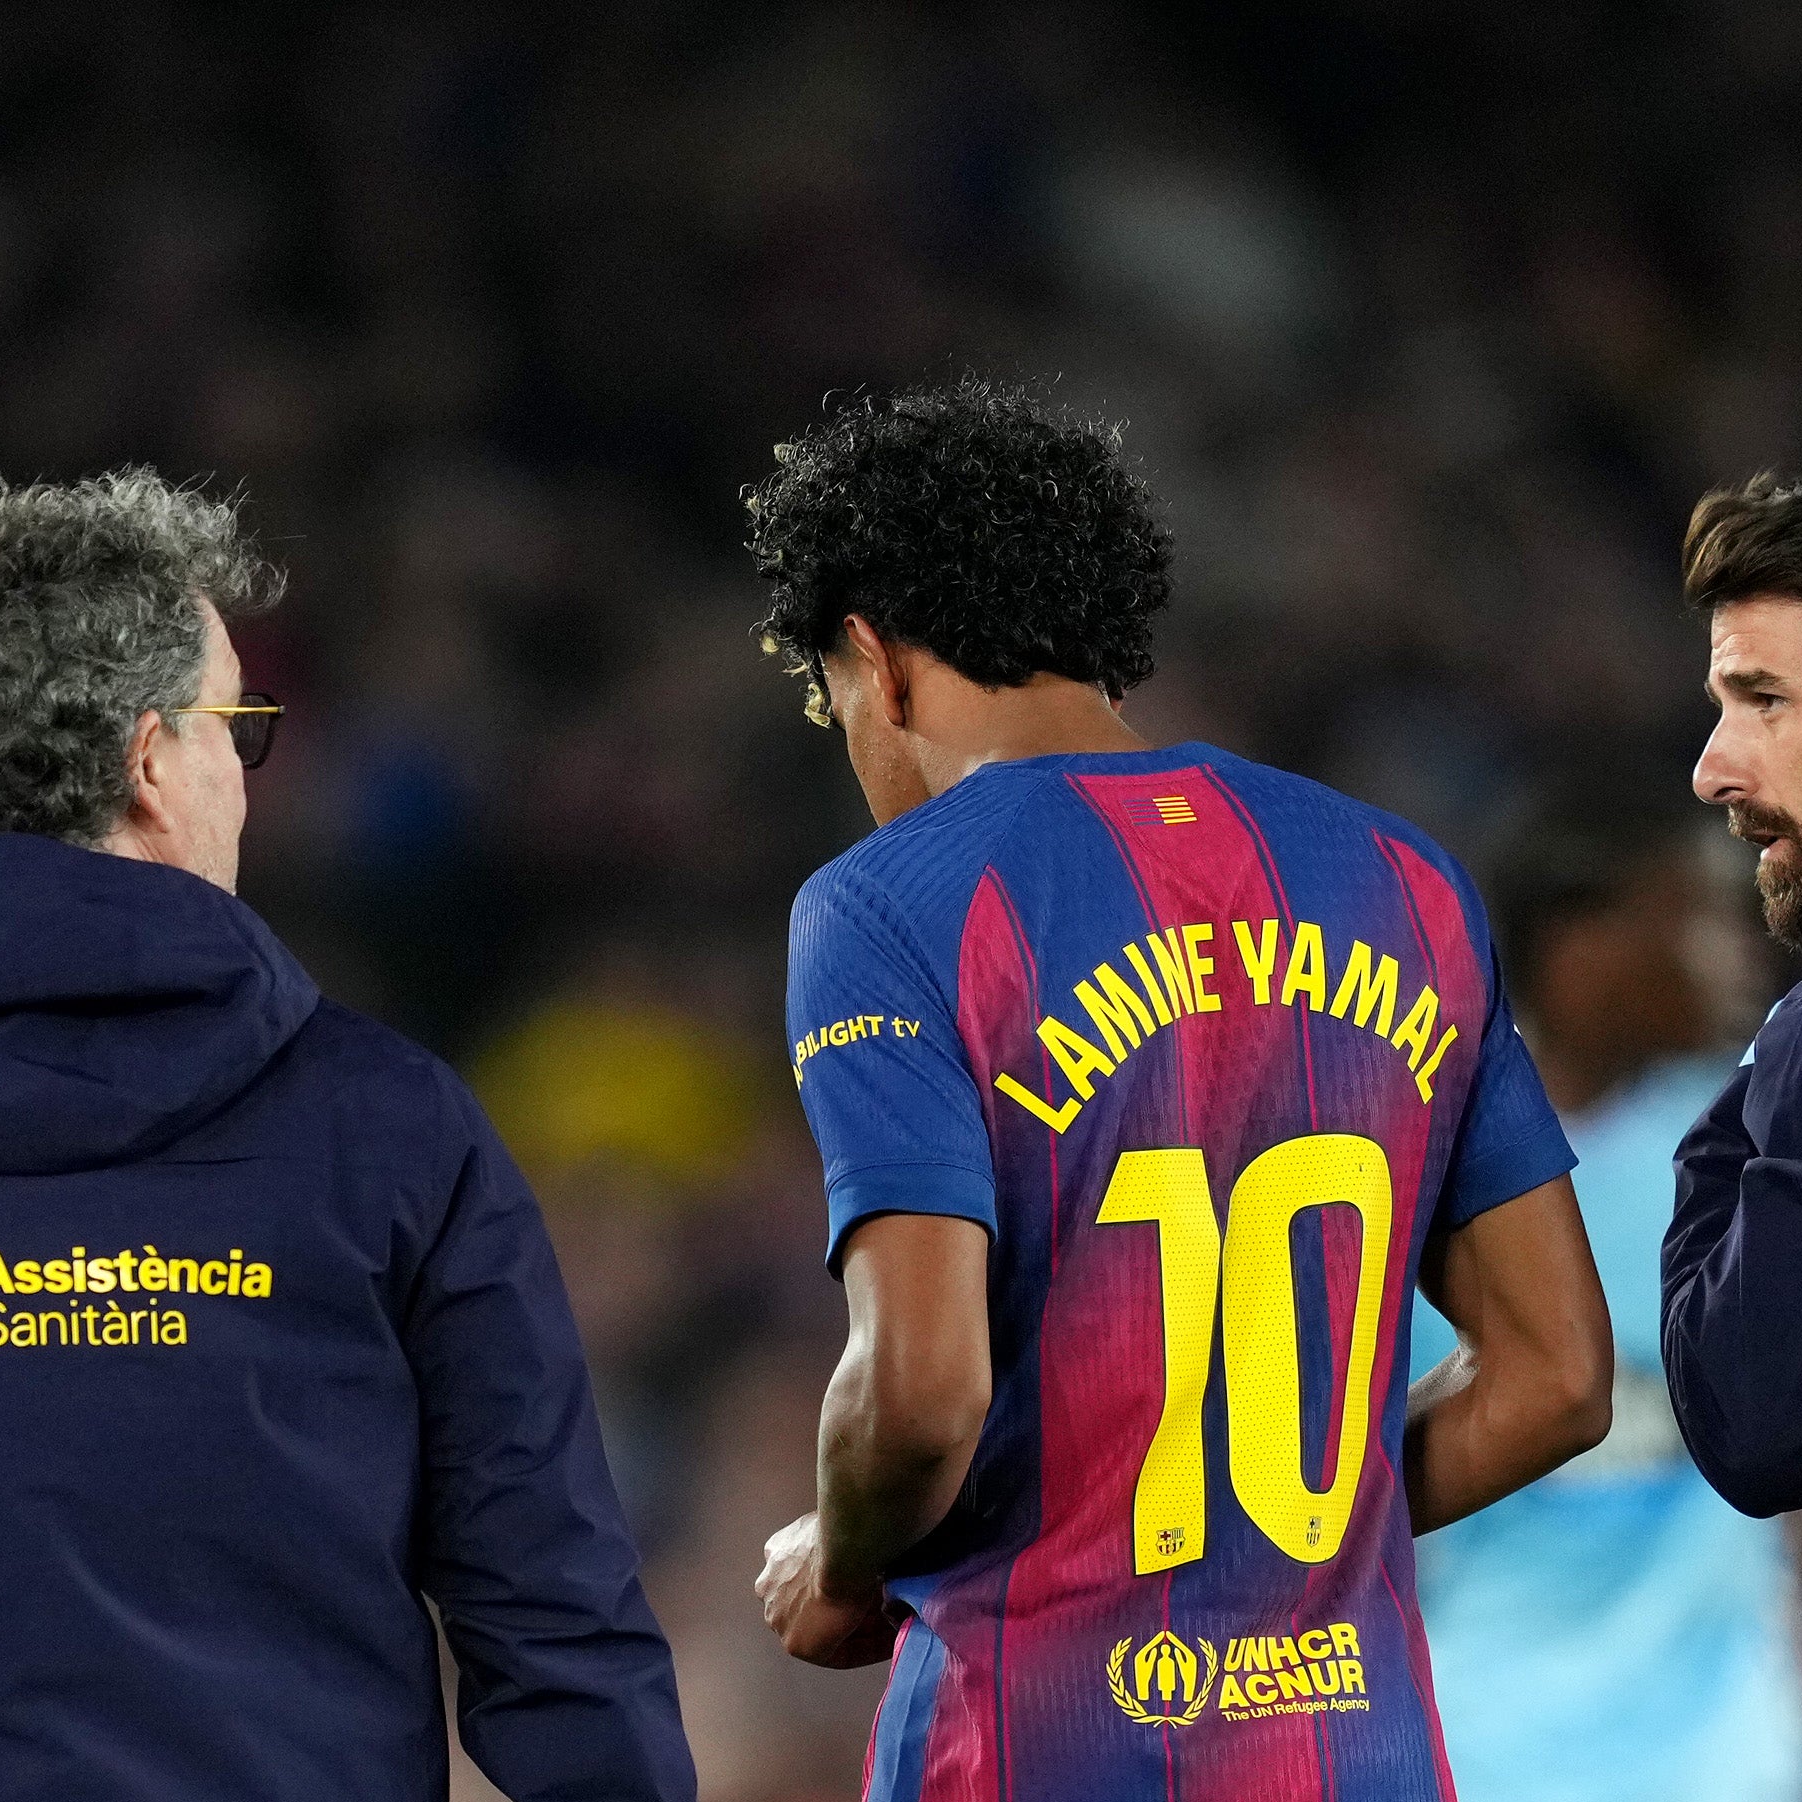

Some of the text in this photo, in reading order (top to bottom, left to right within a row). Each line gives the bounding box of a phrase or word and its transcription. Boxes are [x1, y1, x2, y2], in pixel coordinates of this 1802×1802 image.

[891, 1016, 920, 1038] tv
[994, 918, 1459, 1135] LAMINE YAMAL
[1095, 1133, 1393, 1576] 10
[1223, 1622, 1361, 1672] UNHCR
[1218, 1659, 1366, 1709] ACNUR
[1222, 1697, 1370, 1722] The UN Refugee Agency
